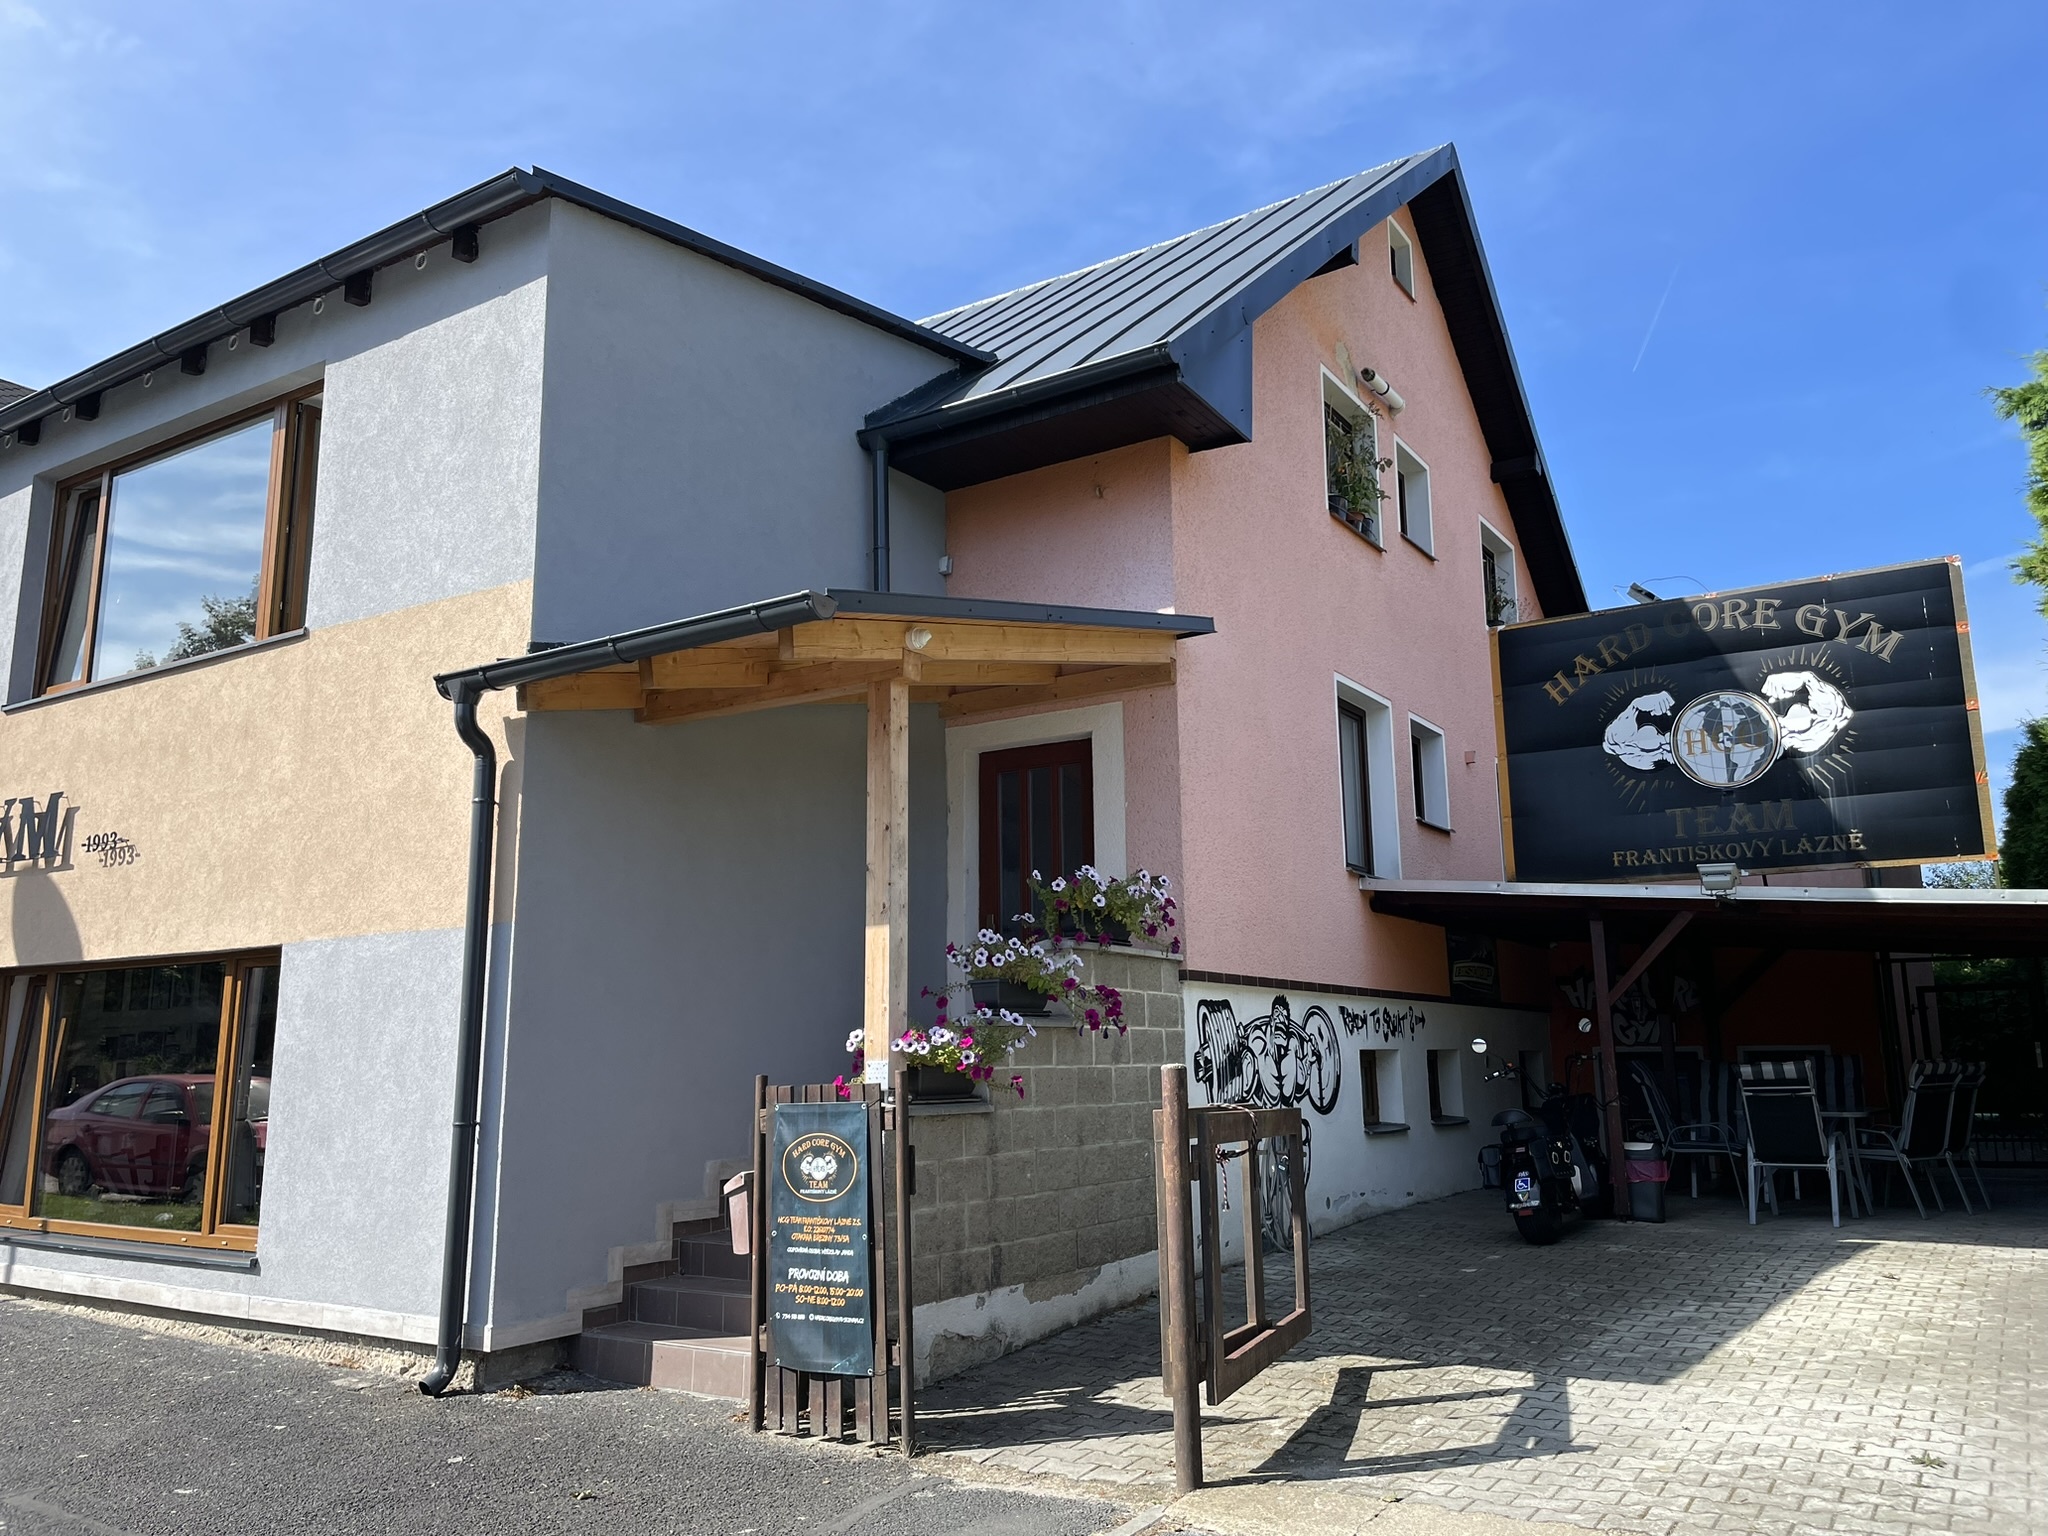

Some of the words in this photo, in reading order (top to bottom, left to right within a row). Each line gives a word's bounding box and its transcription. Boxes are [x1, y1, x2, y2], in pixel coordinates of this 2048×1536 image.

[1542, 622, 1651, 706] HARD
[1663, 598, 1783, 636] CORE
[1795, 603, 1904, 664] GYM
[1665, 798, 1798, 840] TEAM
[1612, 836, 1776, 868] FRANTIŠKOVY
[1781, 828, 1868, 857] LÁZNĚ
[792, 1140, 812, 1158] HARD
[812, 1138, 830, 1148] CORE
[830, 1142, 846, 1158] GYM
[810, 1180, 828, 1188] TEAM
[788, 1268, 826, 1282] PROVOZNÍ
[826, 1270, 848, 1284] DOBA
[776, 1282, 798, 1294] PO-PÁ
[796, 1294, 816, 1304] SO-NE
